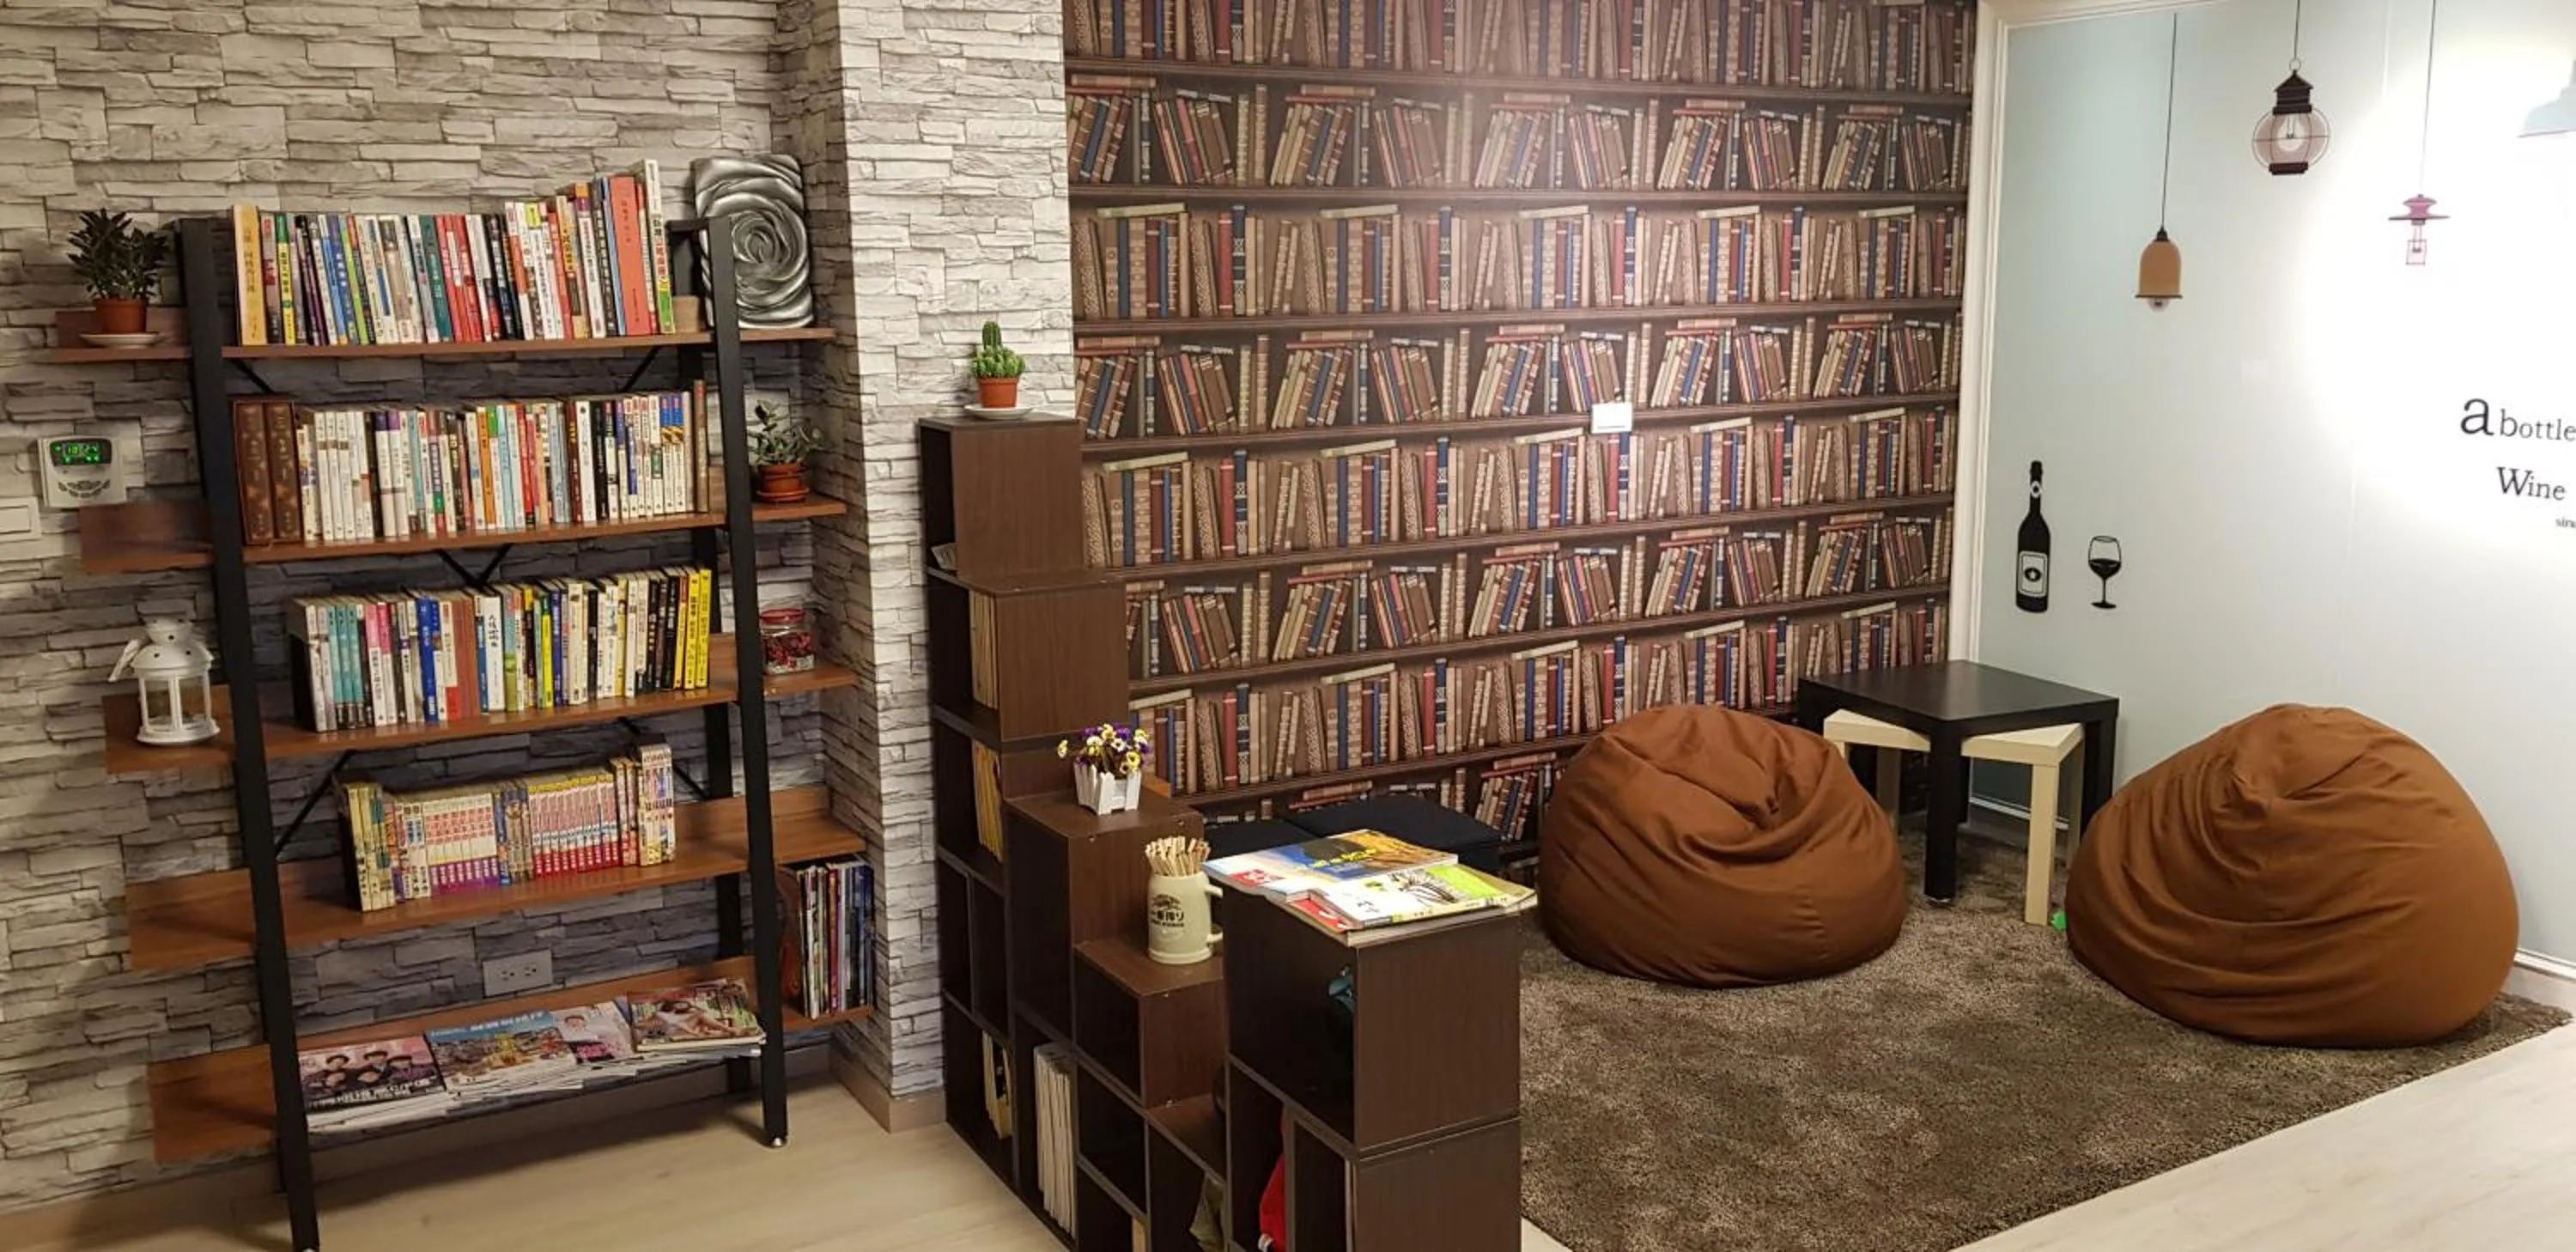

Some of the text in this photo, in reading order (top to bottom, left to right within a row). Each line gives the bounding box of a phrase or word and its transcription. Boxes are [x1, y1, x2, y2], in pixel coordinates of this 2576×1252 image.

[2460, 398, 2576, 442] a bottle
[2496, 466, 2567, 501] Wine
